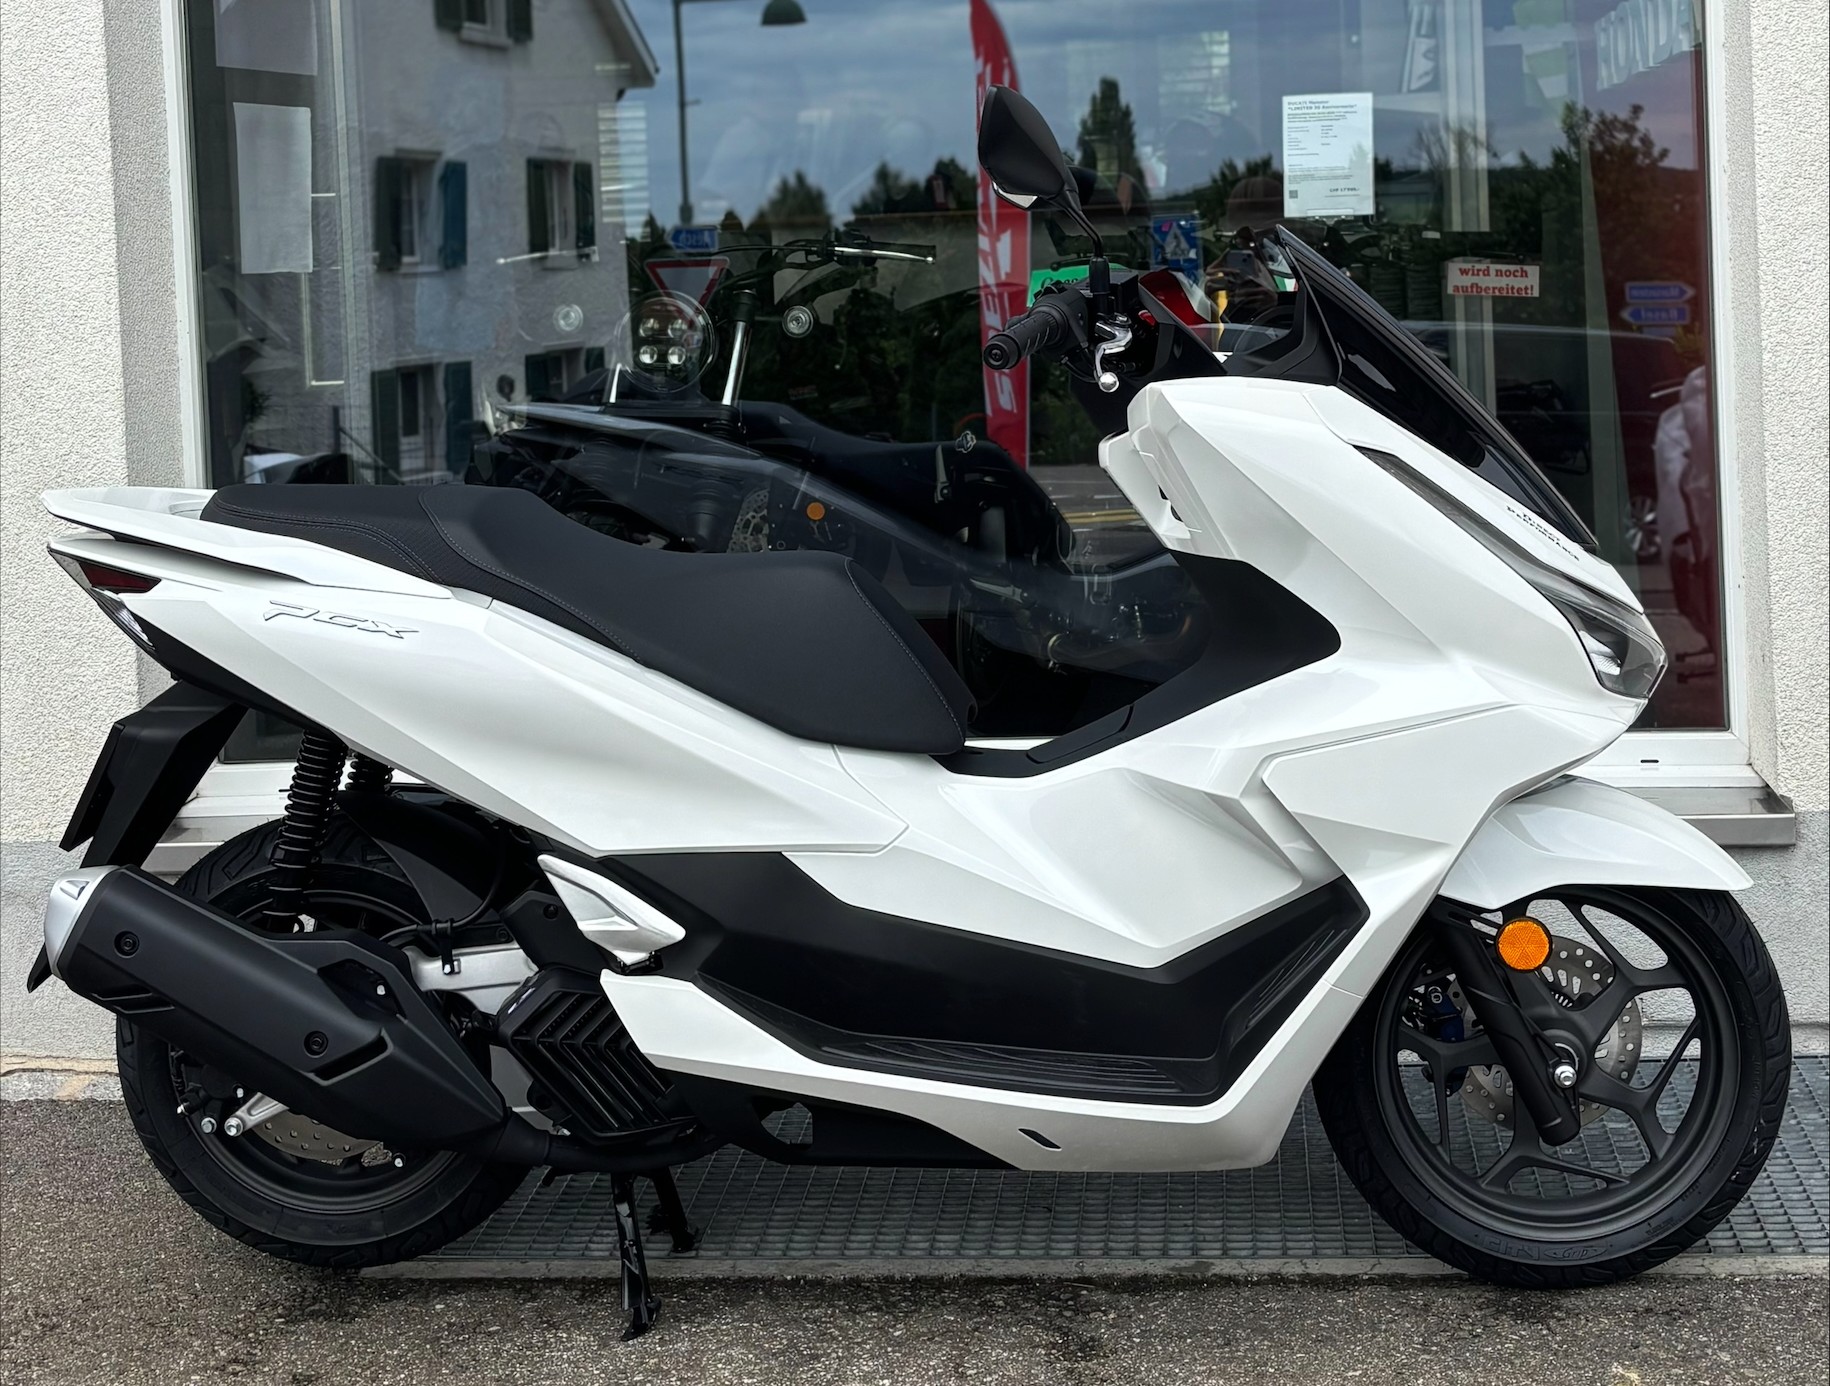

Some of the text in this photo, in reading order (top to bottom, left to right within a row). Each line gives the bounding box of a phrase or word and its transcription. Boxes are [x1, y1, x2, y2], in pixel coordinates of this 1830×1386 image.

[1459, 265, 1528, 278] wird noch
[1452, 283, 1534, 296] aufbereitet!
[263, 600, 419, 639] PCX
[1561, 1247, 1589, 1260] Grip
